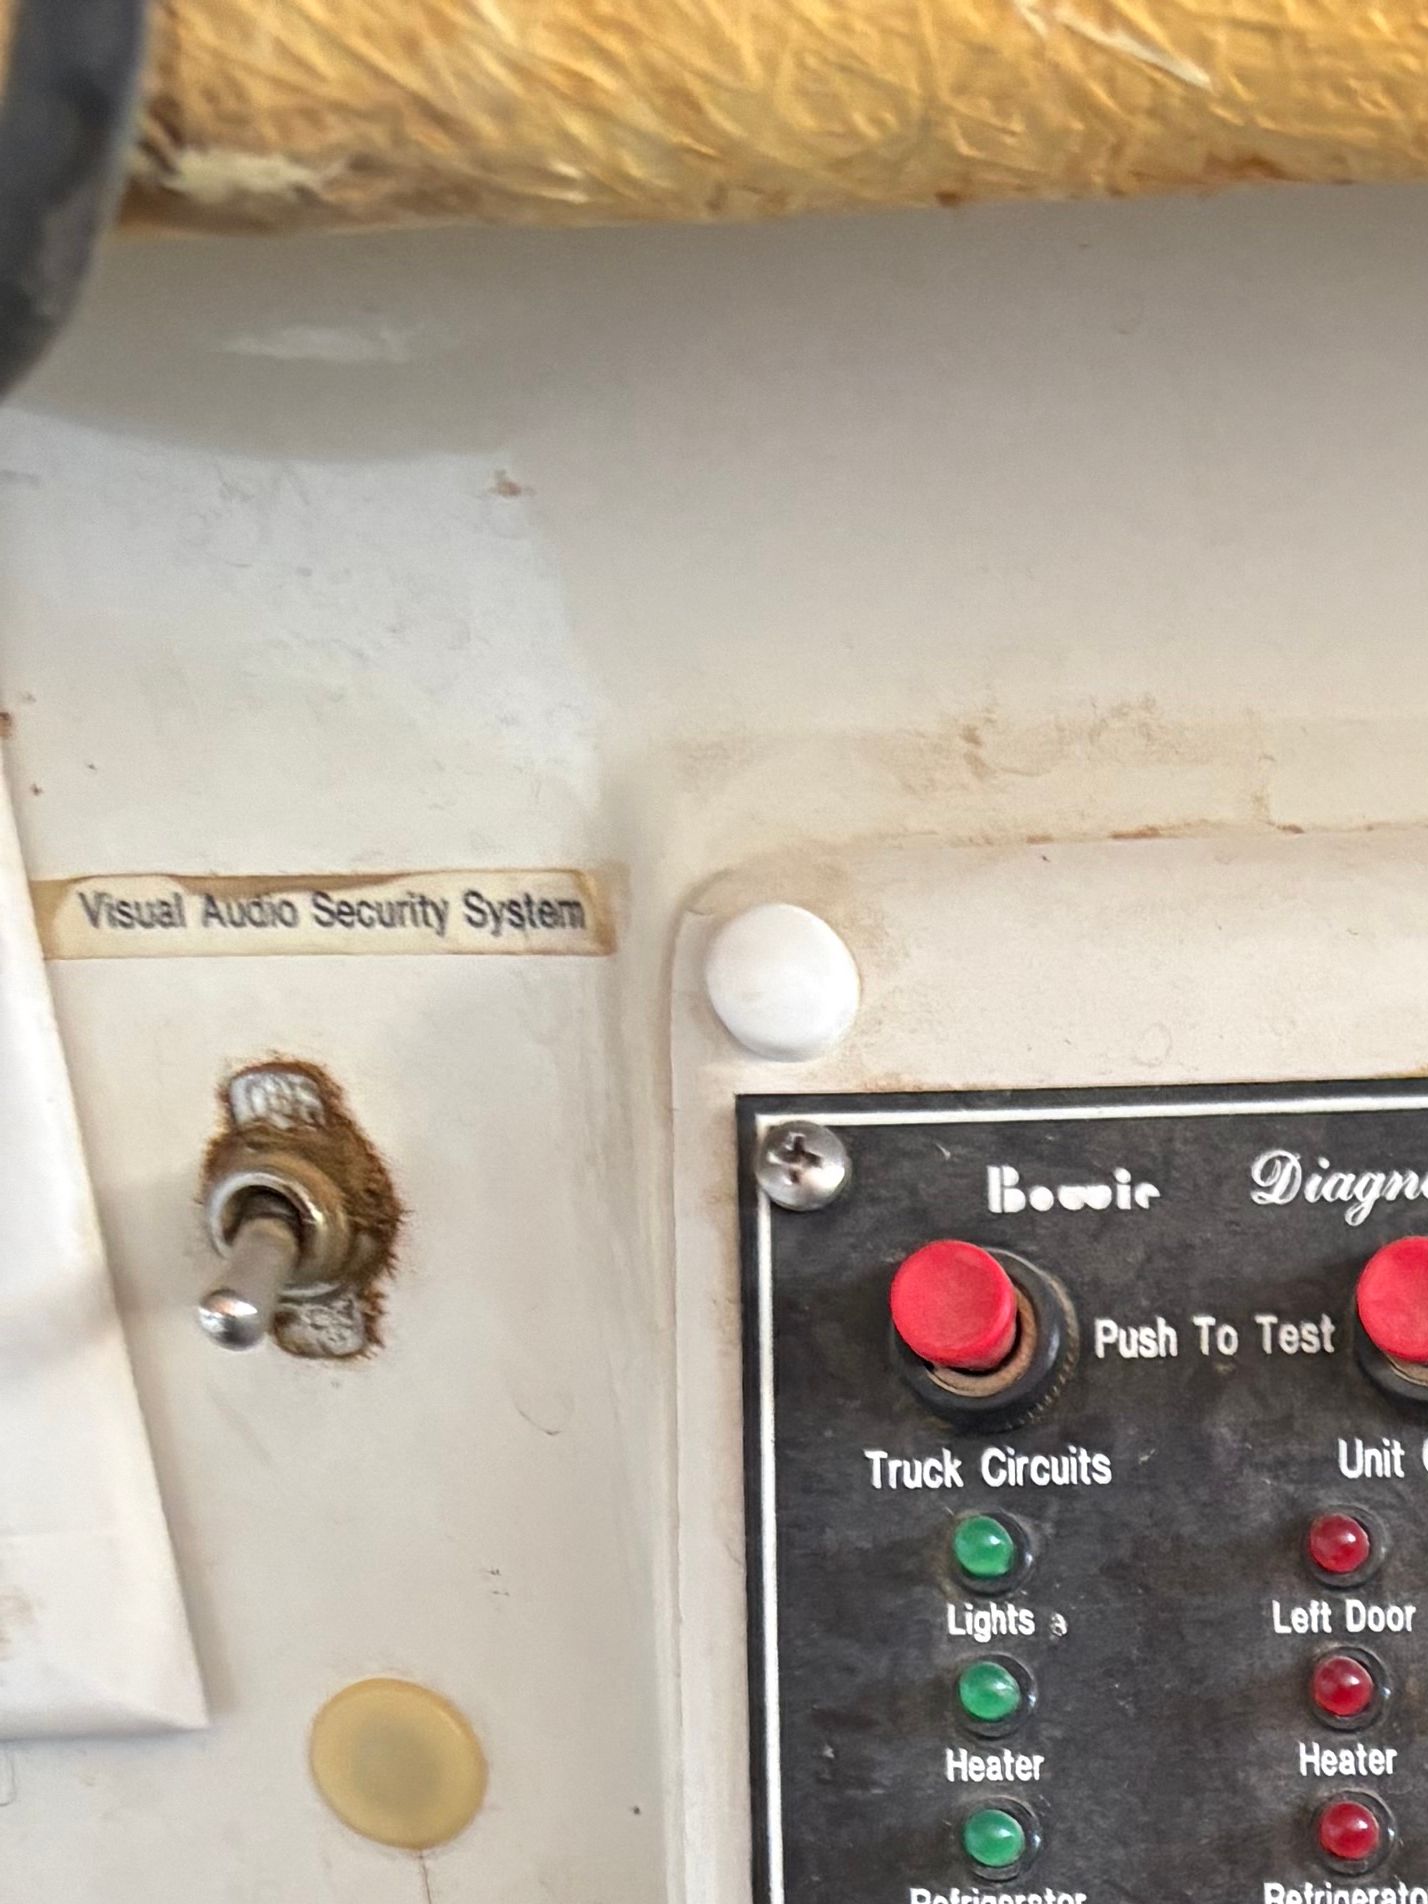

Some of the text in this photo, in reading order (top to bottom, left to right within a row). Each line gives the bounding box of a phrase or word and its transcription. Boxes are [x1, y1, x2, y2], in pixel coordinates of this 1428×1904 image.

[79, 888, 586, 937] Visual Audio Security System
[1094, 1313, 1335, 1359] Push To Test
[864, 1445, 1113, 1490] Truck Circuits
[1338, 1437, 1406, 1479] Unit
[946, 1601, 1036, 1643] Lights
[1272, 1598, 1417, 1634] Left Door
[945, 1747, 1045, 1783] Heater
[1298, 1741, 1398, 1777] Heater
